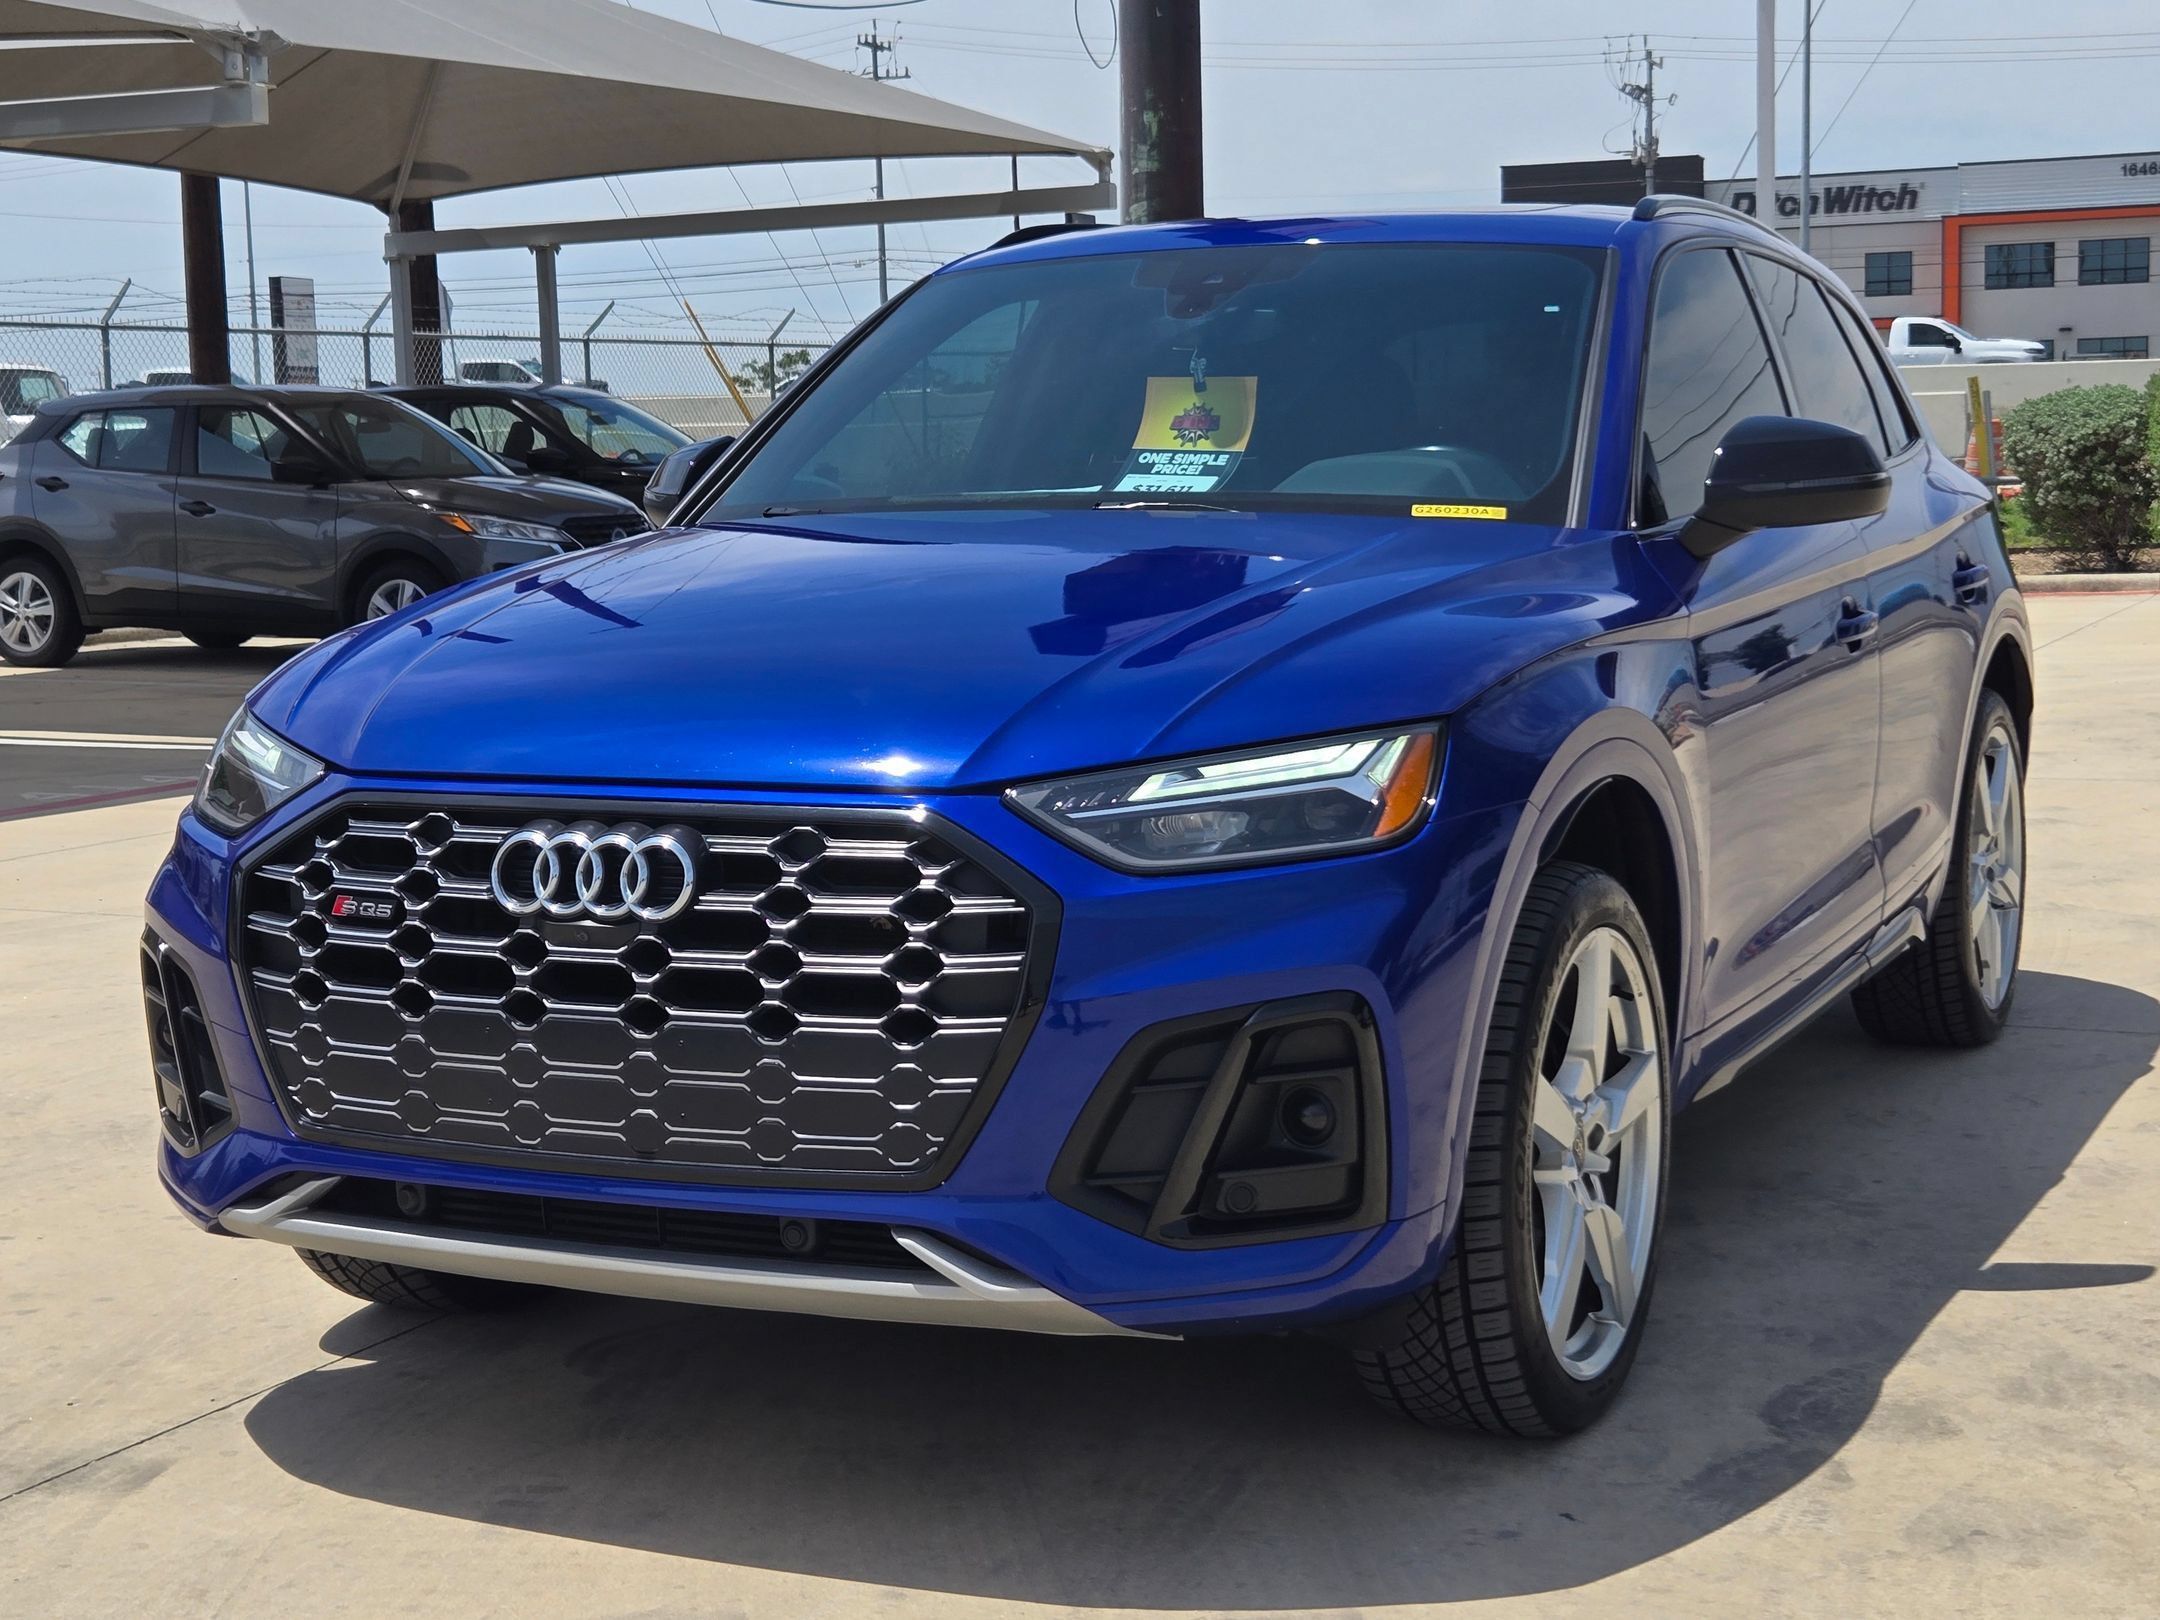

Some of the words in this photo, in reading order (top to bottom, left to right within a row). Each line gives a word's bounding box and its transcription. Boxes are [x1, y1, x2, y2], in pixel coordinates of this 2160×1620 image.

[2120, 161, 2160, 177] 1646
[1823, 182, 1919, 214] Witch
[1138, 452, 1172, 464] ONE
[1172, 453, 1230, 466] SIMPLE
[1150, 464, 1204, 475] PRICE!
[1414, 506, 1489, 515] G260230A
[341, 900, 393, 918] SQ5
